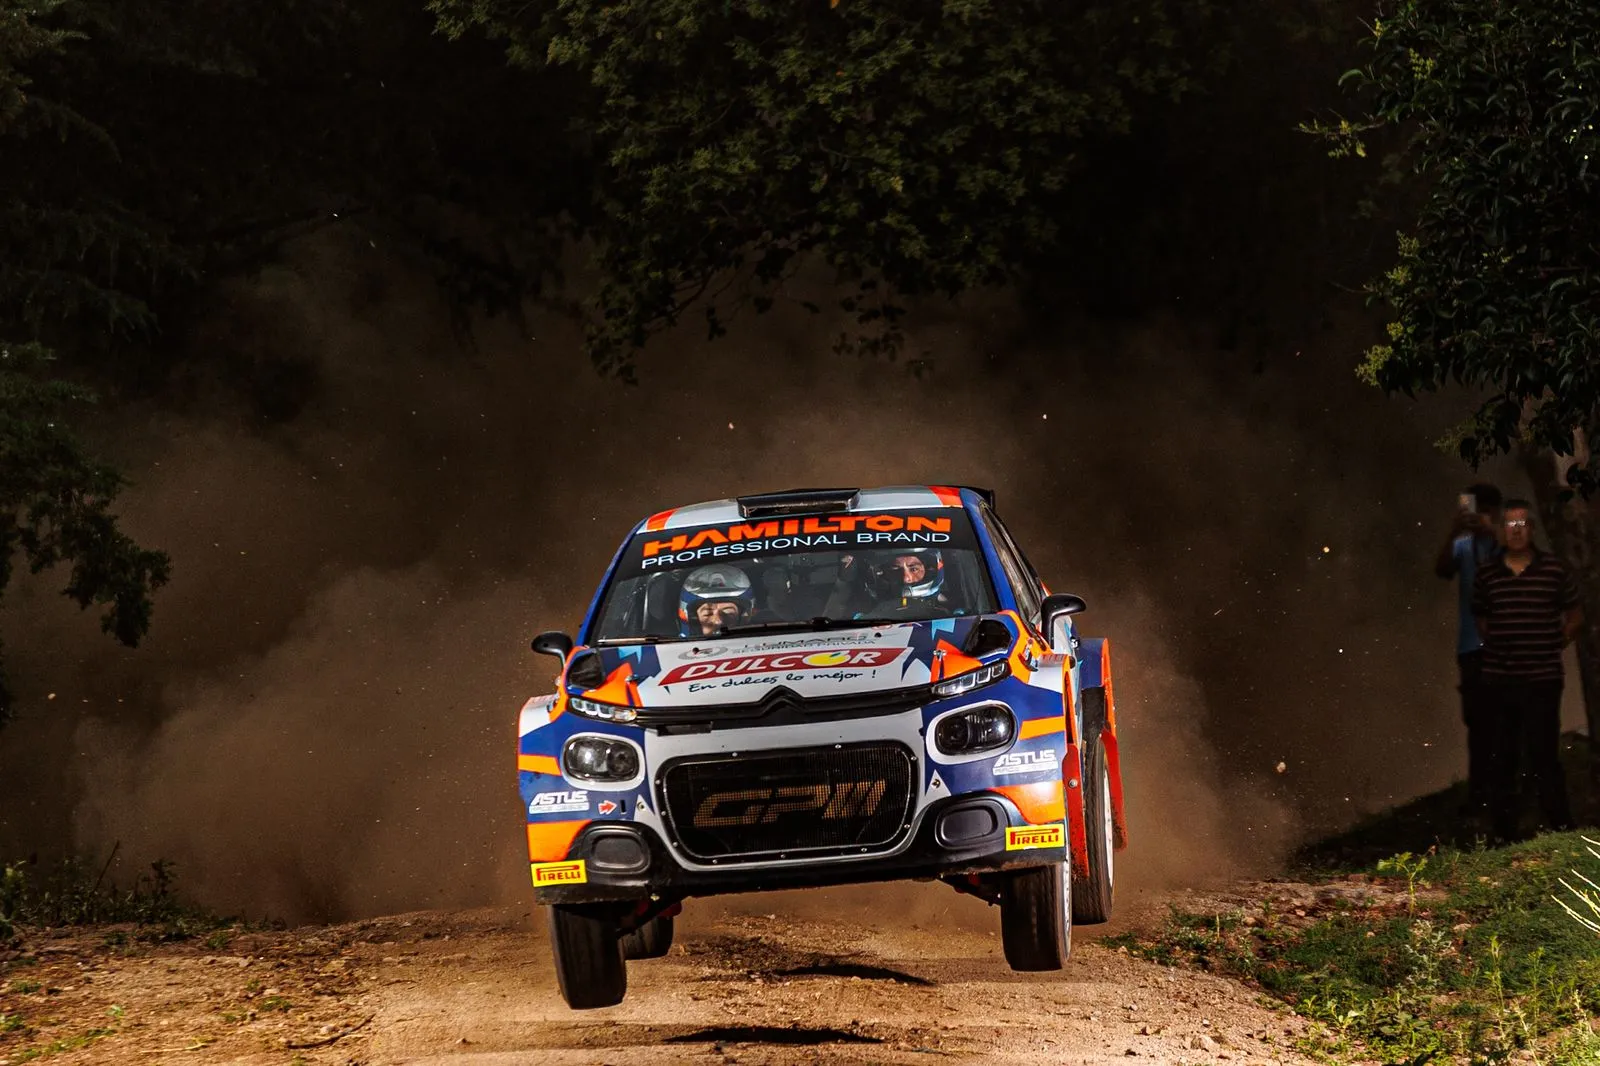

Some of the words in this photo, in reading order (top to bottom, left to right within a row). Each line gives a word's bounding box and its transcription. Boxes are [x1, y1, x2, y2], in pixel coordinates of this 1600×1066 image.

[642, 514, 951, 557] HAMILTON
[641, 533, 847, 570] PROFESSIONAL
[856, 532, 950, 544] BRAND
[679, 650, 882, 679] DULCOR
[688, 681, 717, 693] En
[721, 674, 779, 689] dulces
[785, 671, 804, 682] lo
[812, 669, 864, 683] mejor
[993, 749, 1057, 768] ASTUS
[530, 790, 588, 806] ASTUS
[1009, 828, 1060, 846] PIRELLI
[535, 864, 581, 882] PIRELLI
